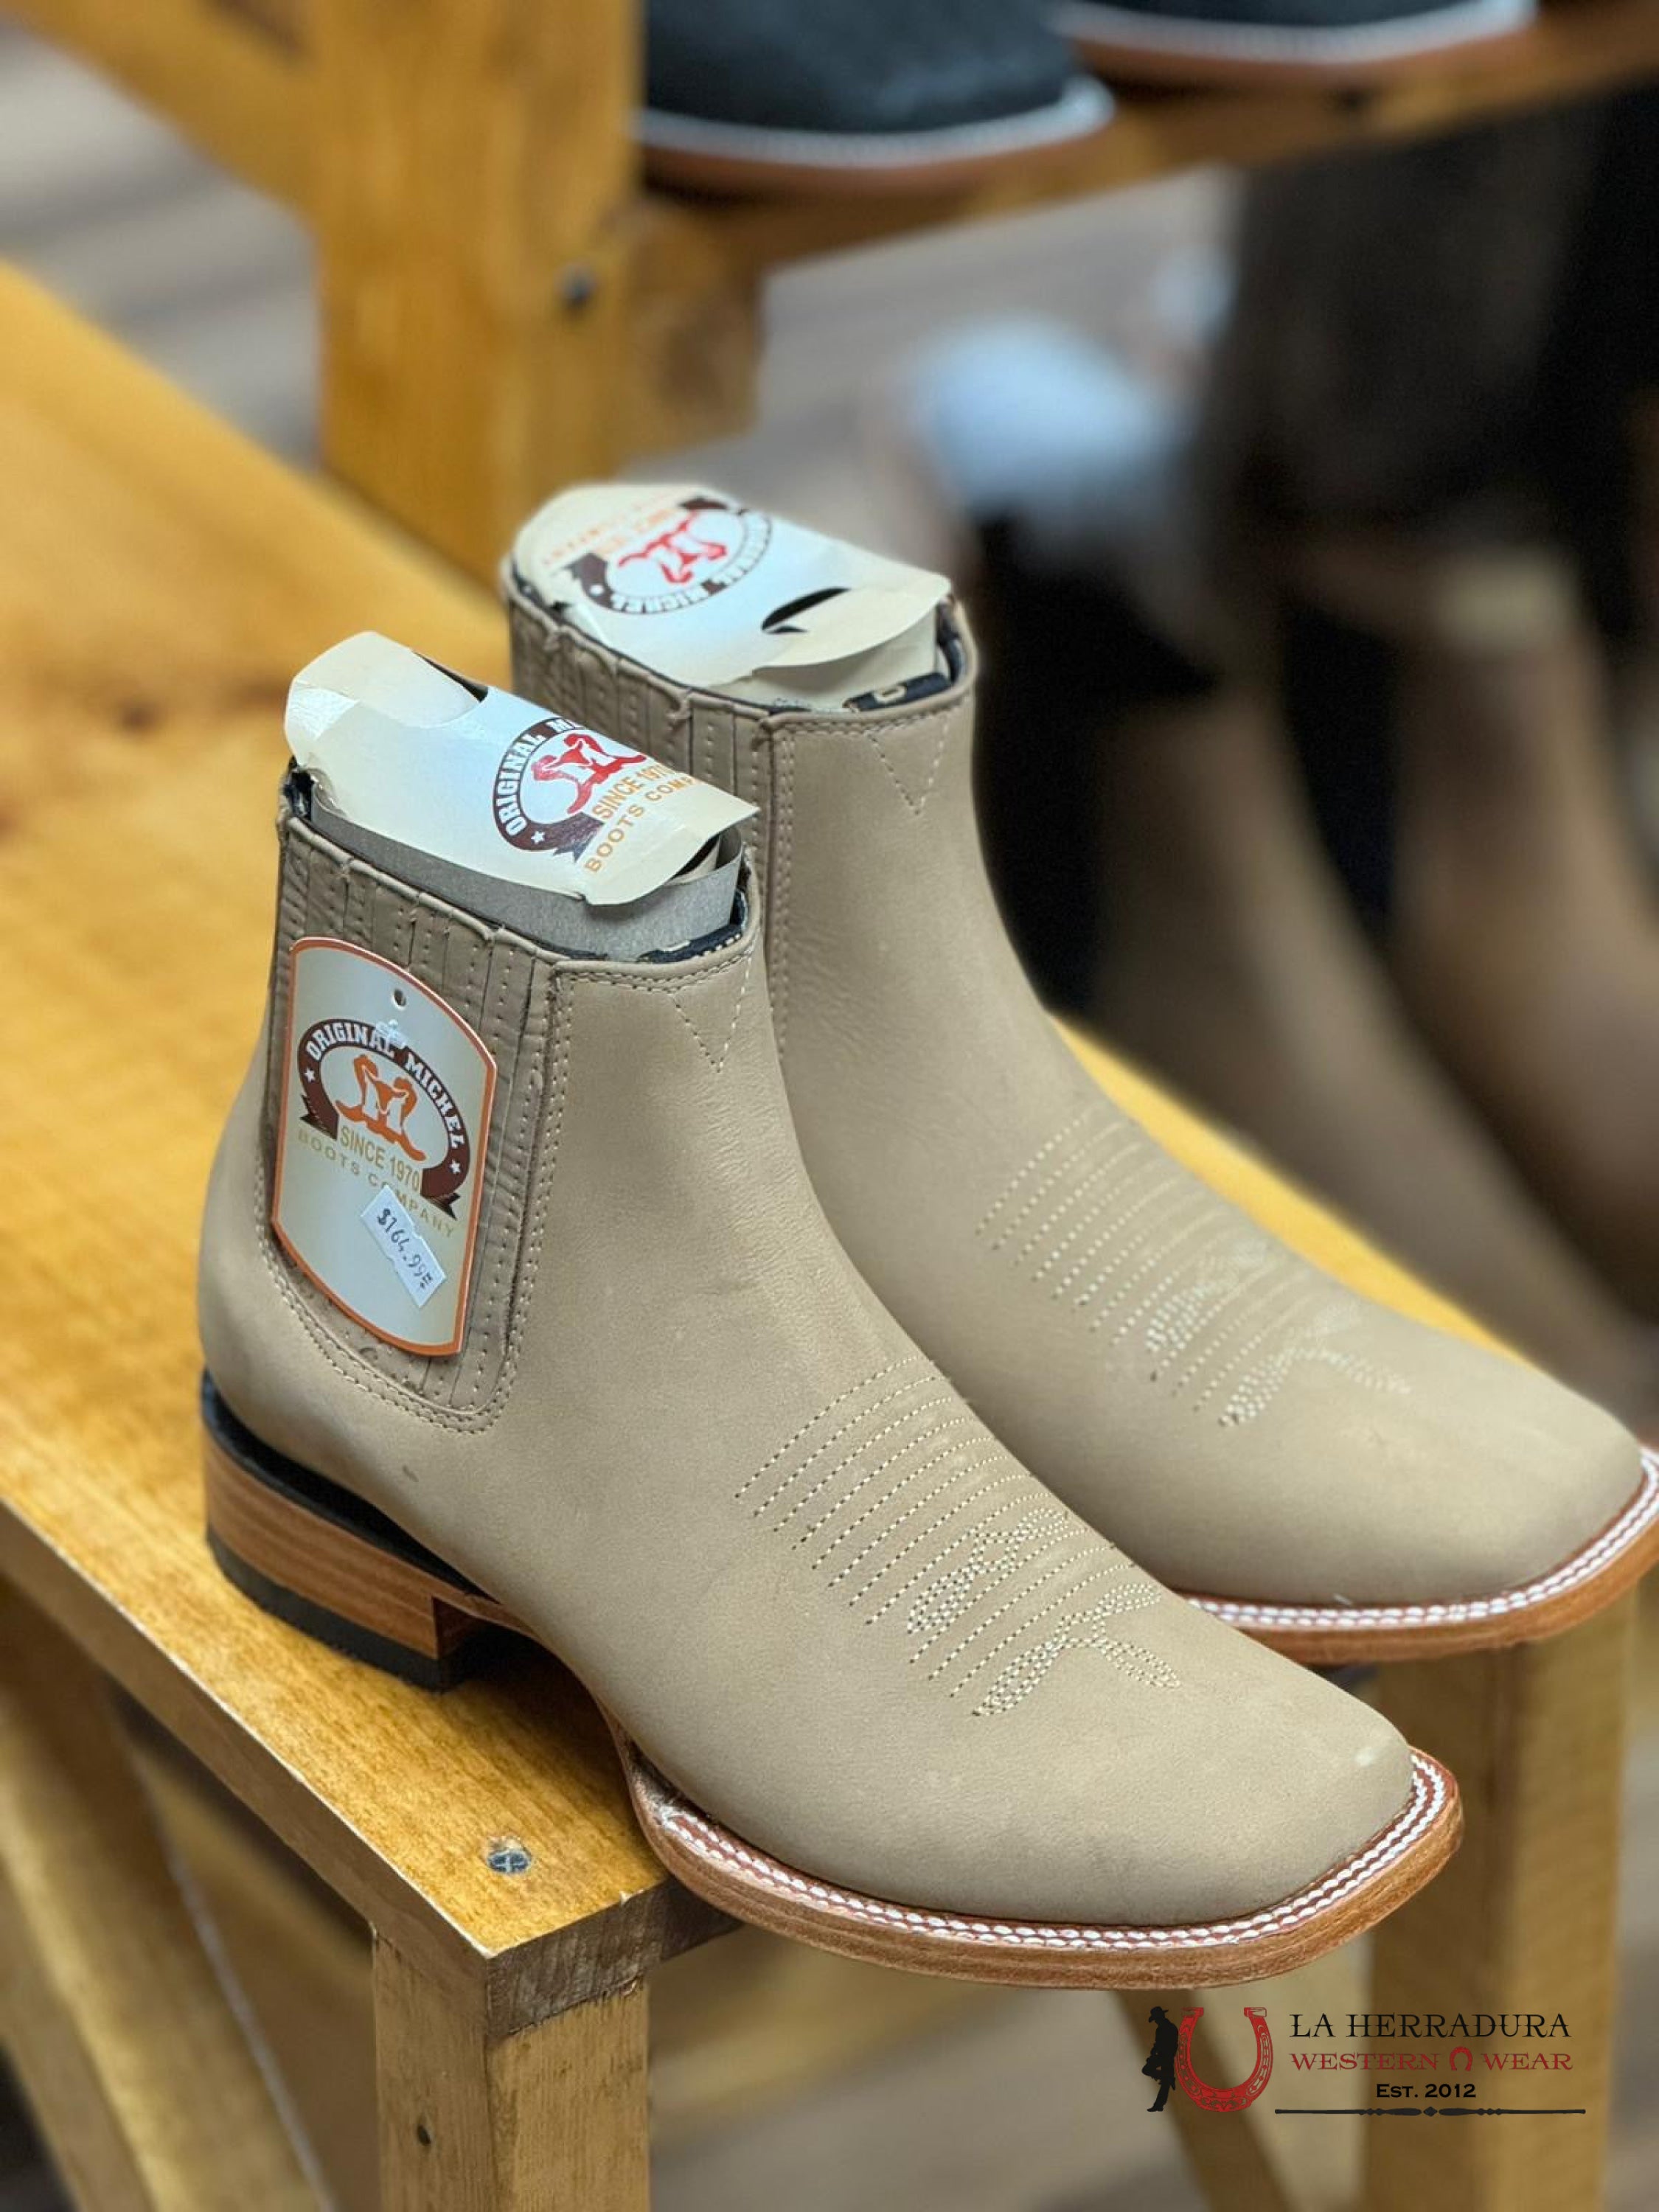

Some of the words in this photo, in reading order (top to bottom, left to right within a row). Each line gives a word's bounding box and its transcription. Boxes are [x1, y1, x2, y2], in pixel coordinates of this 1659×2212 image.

[497, 733, 546, 836] ORIGINAL
[592, 776, 644, 819] SINCE
[585, 804, 644, 872] BOOTS
[305, 1021, 395, 1062] ORIGINAL
[404, 1053, 465, 1149] MICHEL
[299, 1129, 361, 1175] BOOTS
[341, 1126, 386, 1170] SINCE
[389, 1155, 420, 1192] 1970
